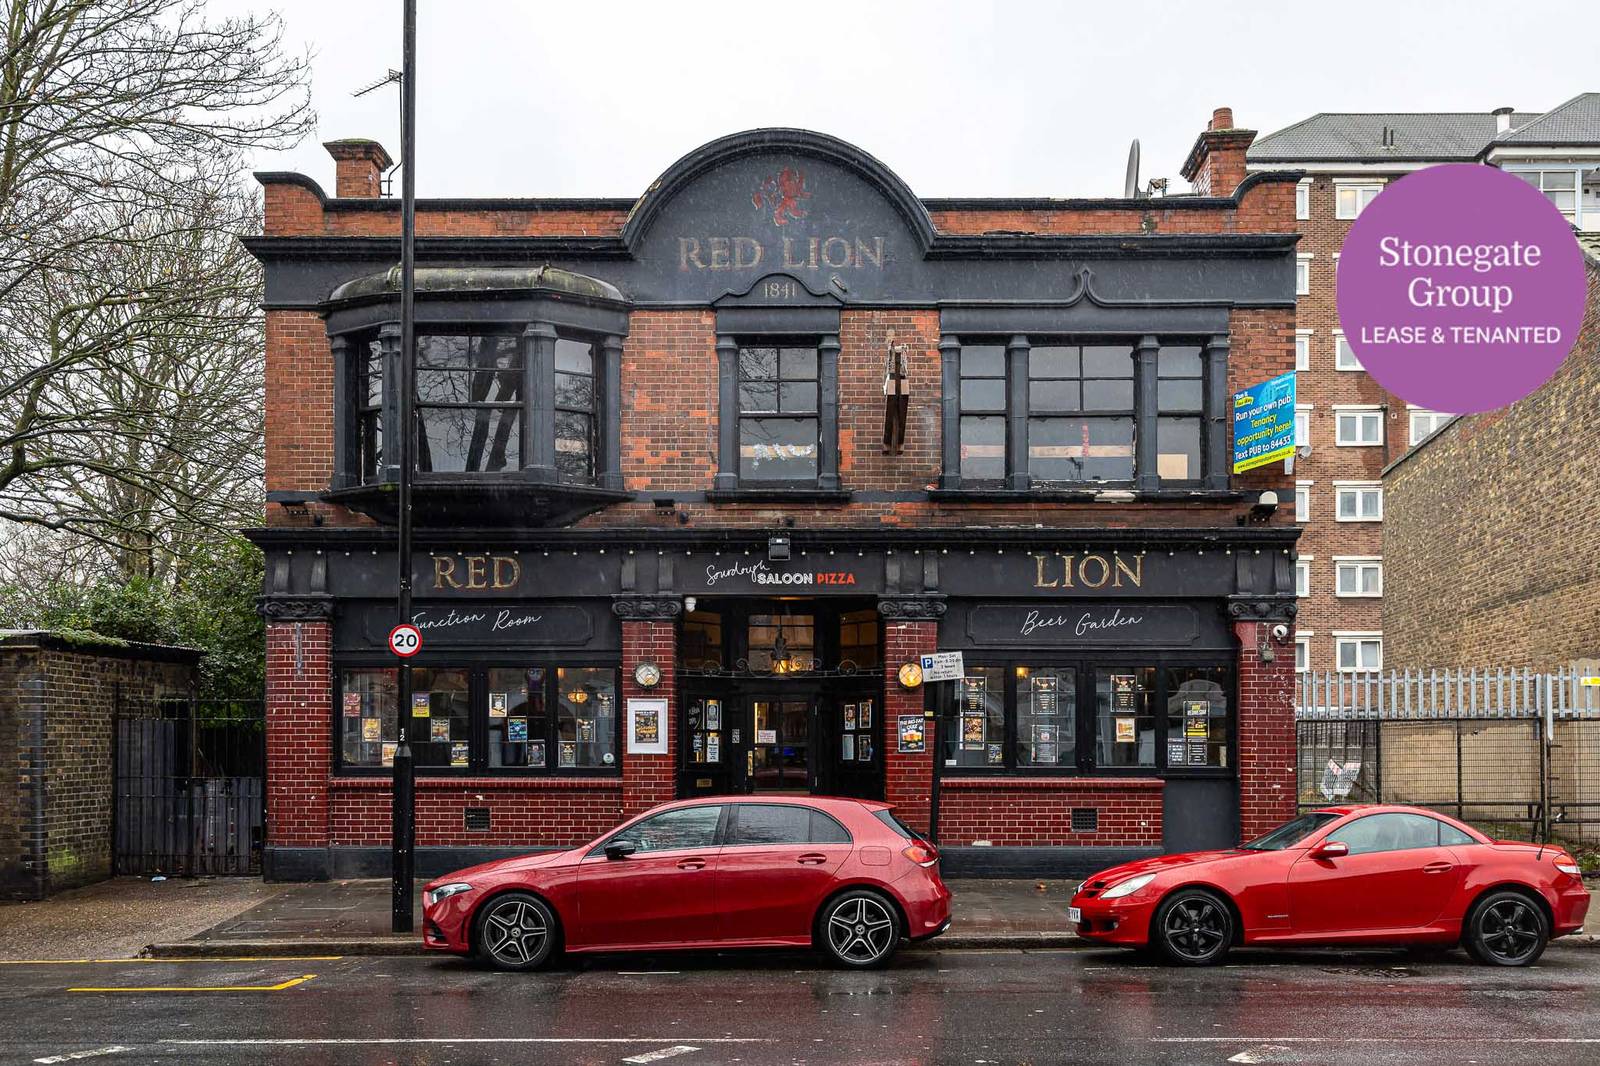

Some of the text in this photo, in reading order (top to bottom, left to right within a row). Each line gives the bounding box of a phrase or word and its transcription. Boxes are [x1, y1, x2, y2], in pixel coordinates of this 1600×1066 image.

[678, 236, 885, 270] RED LION
[1236, 412, 1248, 421] Run
[1249, 406, 1263, 420] your
[1264, 400, 1277, 411] own
[1251, 414, 1277, 429] Tenancy
[1235, 450, 1248, 461] Text
[1249, 445, 1262, 456] PUB
[1263, 444, 1270, 452] to
[1271, 435, 1291, 450] 84433
[1237, 428, 1273, 446] opportunity
[433, 556, 521, 589] RED
[706, 560, 770, 585] Sourdough
[757, 573, 855, 584] SALOON PIZZA
[1033, 555, 1144, 588] LION
[492, 609, 542, 631] Room
[1020, 608, 1143, 636] Beer Garden
[395, 634, 417, 647] 20
[925, 658, 932, 668] P
